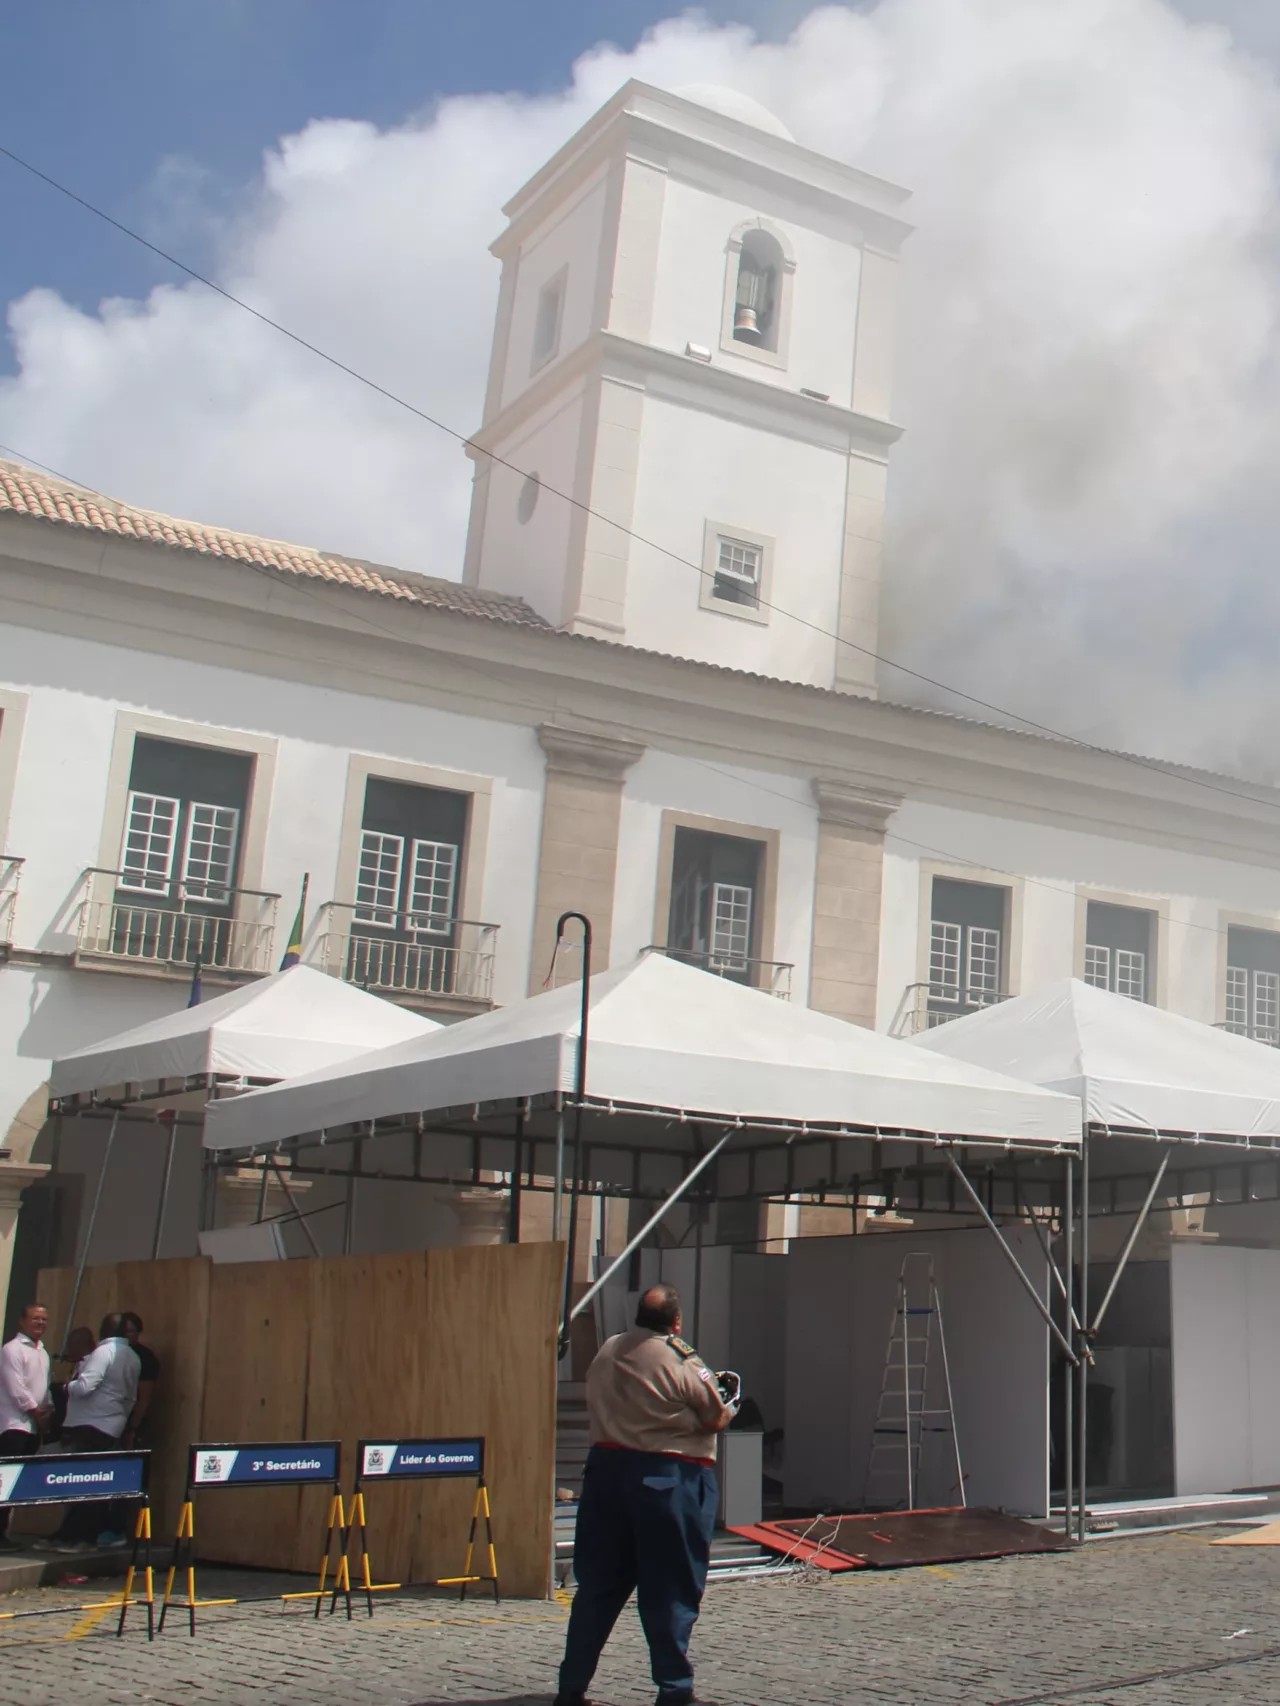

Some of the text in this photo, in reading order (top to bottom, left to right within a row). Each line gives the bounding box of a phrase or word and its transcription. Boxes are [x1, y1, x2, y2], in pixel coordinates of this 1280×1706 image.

[266, 1459, 321, 1471] Secretário
[400, 1454, 474, 1465] Líder do Governo
[46, 1471, 114, 1485] Cerimonial
